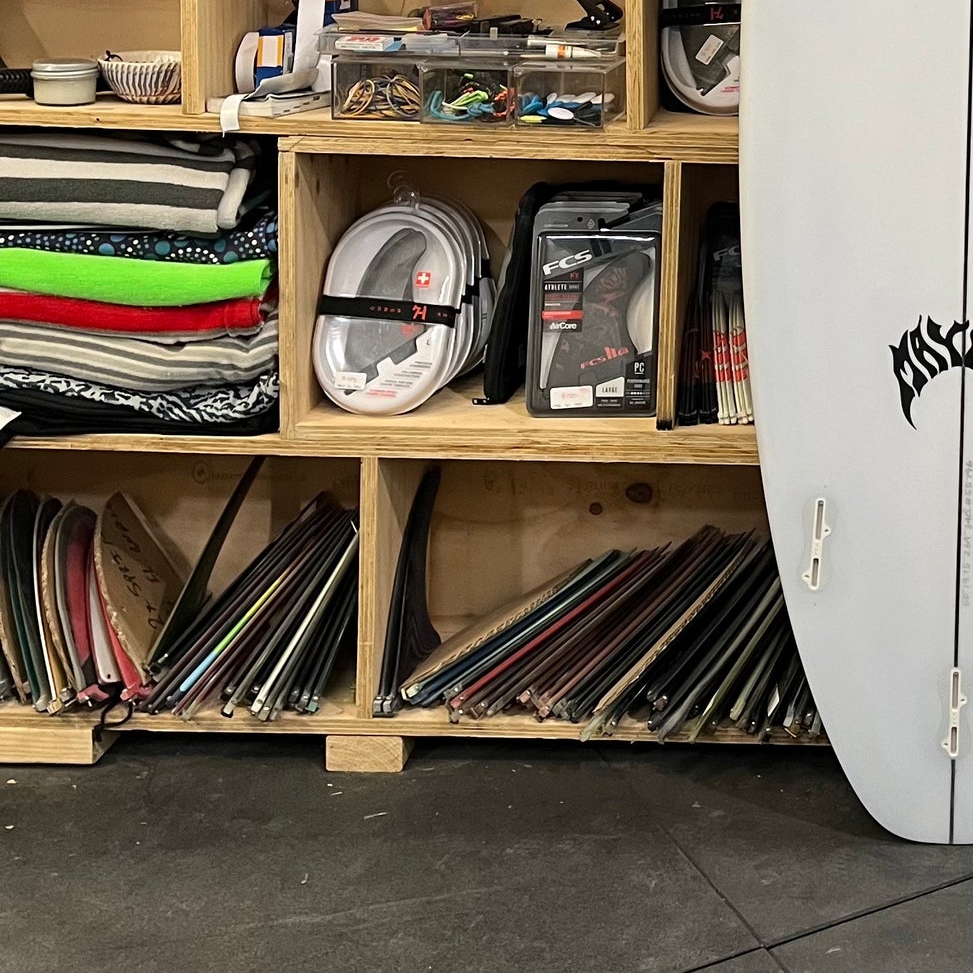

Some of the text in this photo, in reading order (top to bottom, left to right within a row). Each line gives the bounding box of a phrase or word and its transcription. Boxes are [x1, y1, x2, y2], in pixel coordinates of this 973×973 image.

[713, 245, 741, 262] FC
[542, 249, 593, 276] FCS
[634, 362, 645, 373] PC
